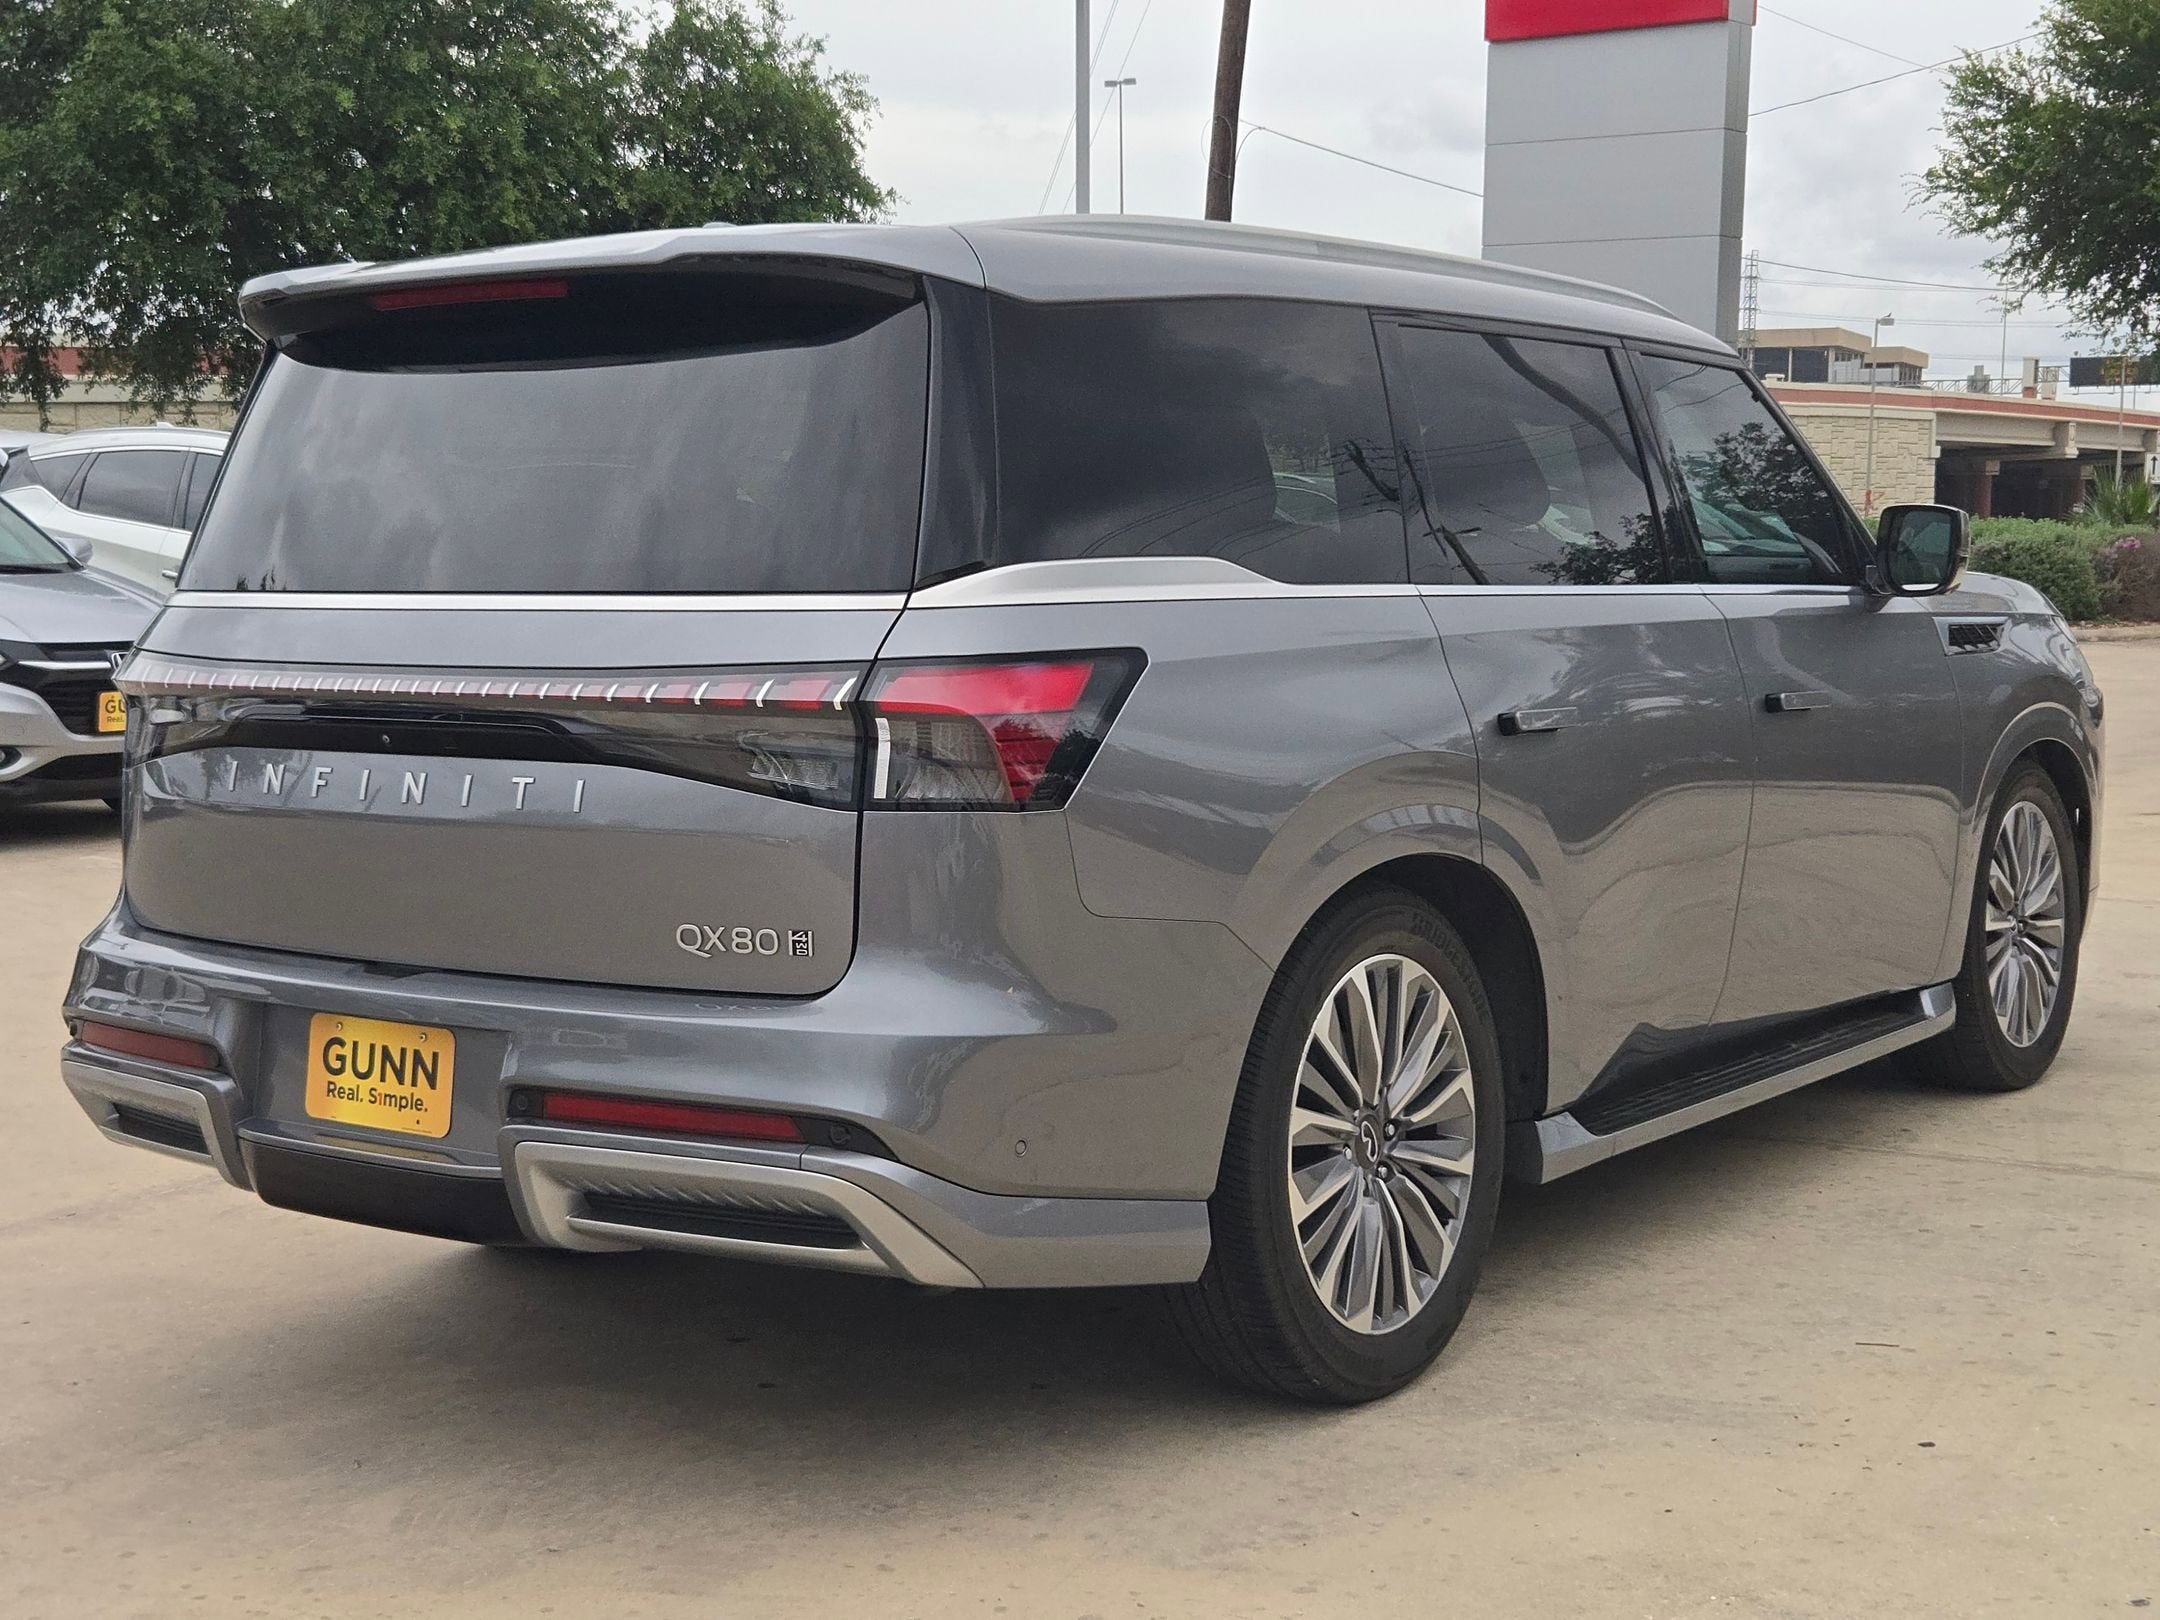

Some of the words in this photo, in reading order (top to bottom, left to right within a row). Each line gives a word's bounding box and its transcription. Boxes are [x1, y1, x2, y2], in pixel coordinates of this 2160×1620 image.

[228, 760, 584, 813] INFINITI
[676, 923, 779, 958] QX80
[322, 1036, 440, 1091] GUNN
[326, 1080, 363, 1103] Real.
